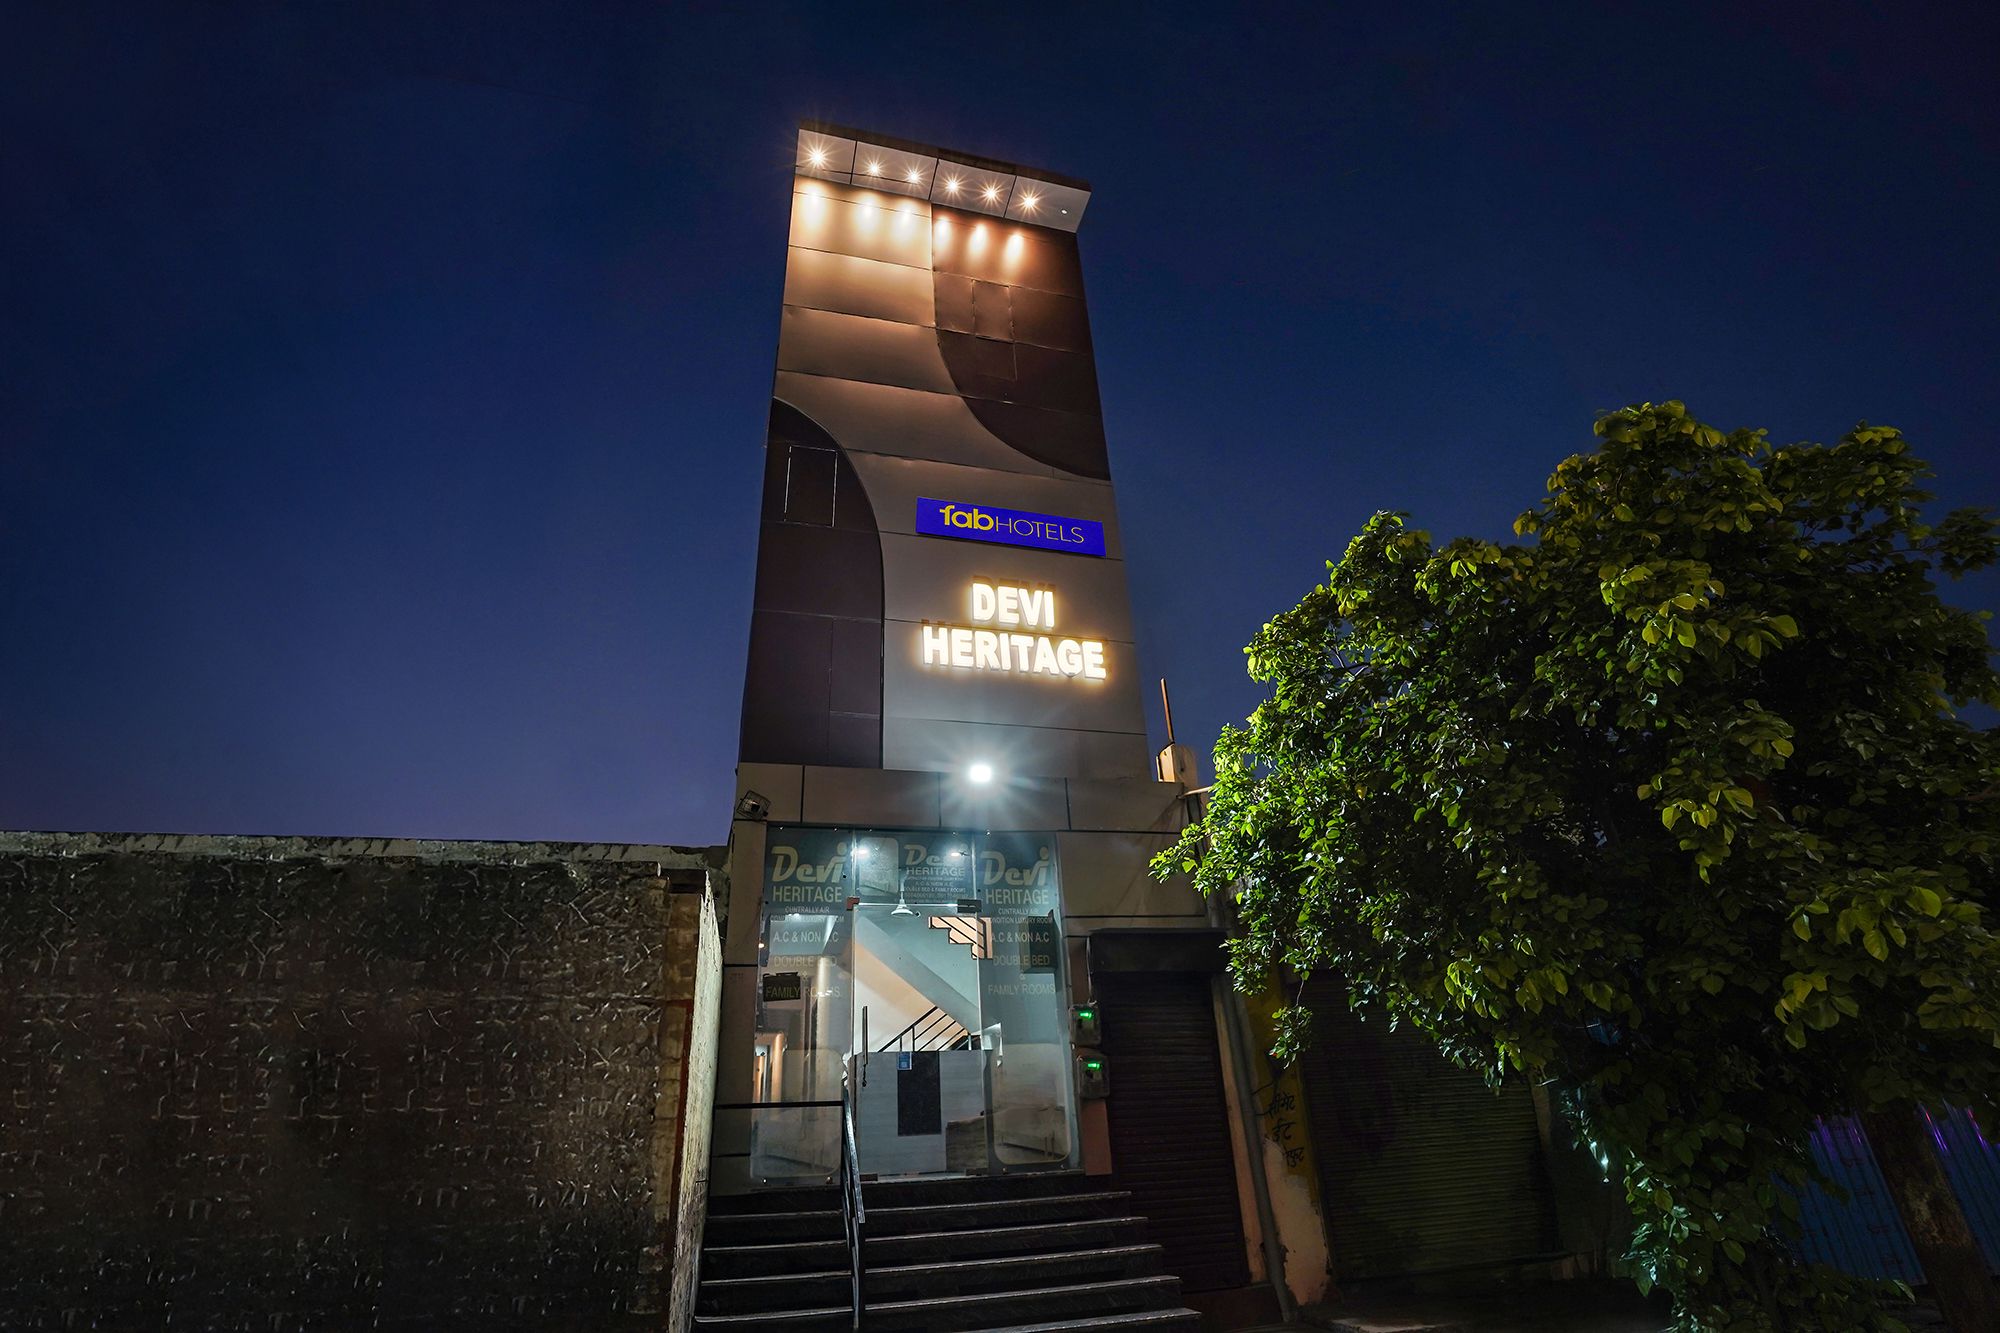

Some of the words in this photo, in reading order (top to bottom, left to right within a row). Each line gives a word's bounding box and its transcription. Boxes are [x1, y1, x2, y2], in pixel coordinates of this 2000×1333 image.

[972, 582, 1055, 628] DEVI
[923, 626, 1106, 680] HERITAGE
[771, 842, 847, 883] Devi
[904, 843, 968, 867] De
[906, 867, 965, 877] HERITAGE
[980, 846, 1049, 886] Devi
[773, 886, 842, 903] HERITAGE
[985, 888, 1050, 905] HERITAGE
[792, 932, 799, 943] &
[801, 931, 821, 943] NON
[823, 931, 839, 943] .C
[1007, 932, 1014, 943] &
[1015, 932, 1033, 943] NON
[774, 955, 814, 968] DOUBLE
[992, 954, 1030, 966] DOUBLE
[1032, 955, 1050, 966] BED
[766, 985, 800, 999] FAMILY
[803, 985, 841, 999] ROS
[988, 983, 1020, 996] FAMILY
[1022, 983, 1056, 996] ROOMS
